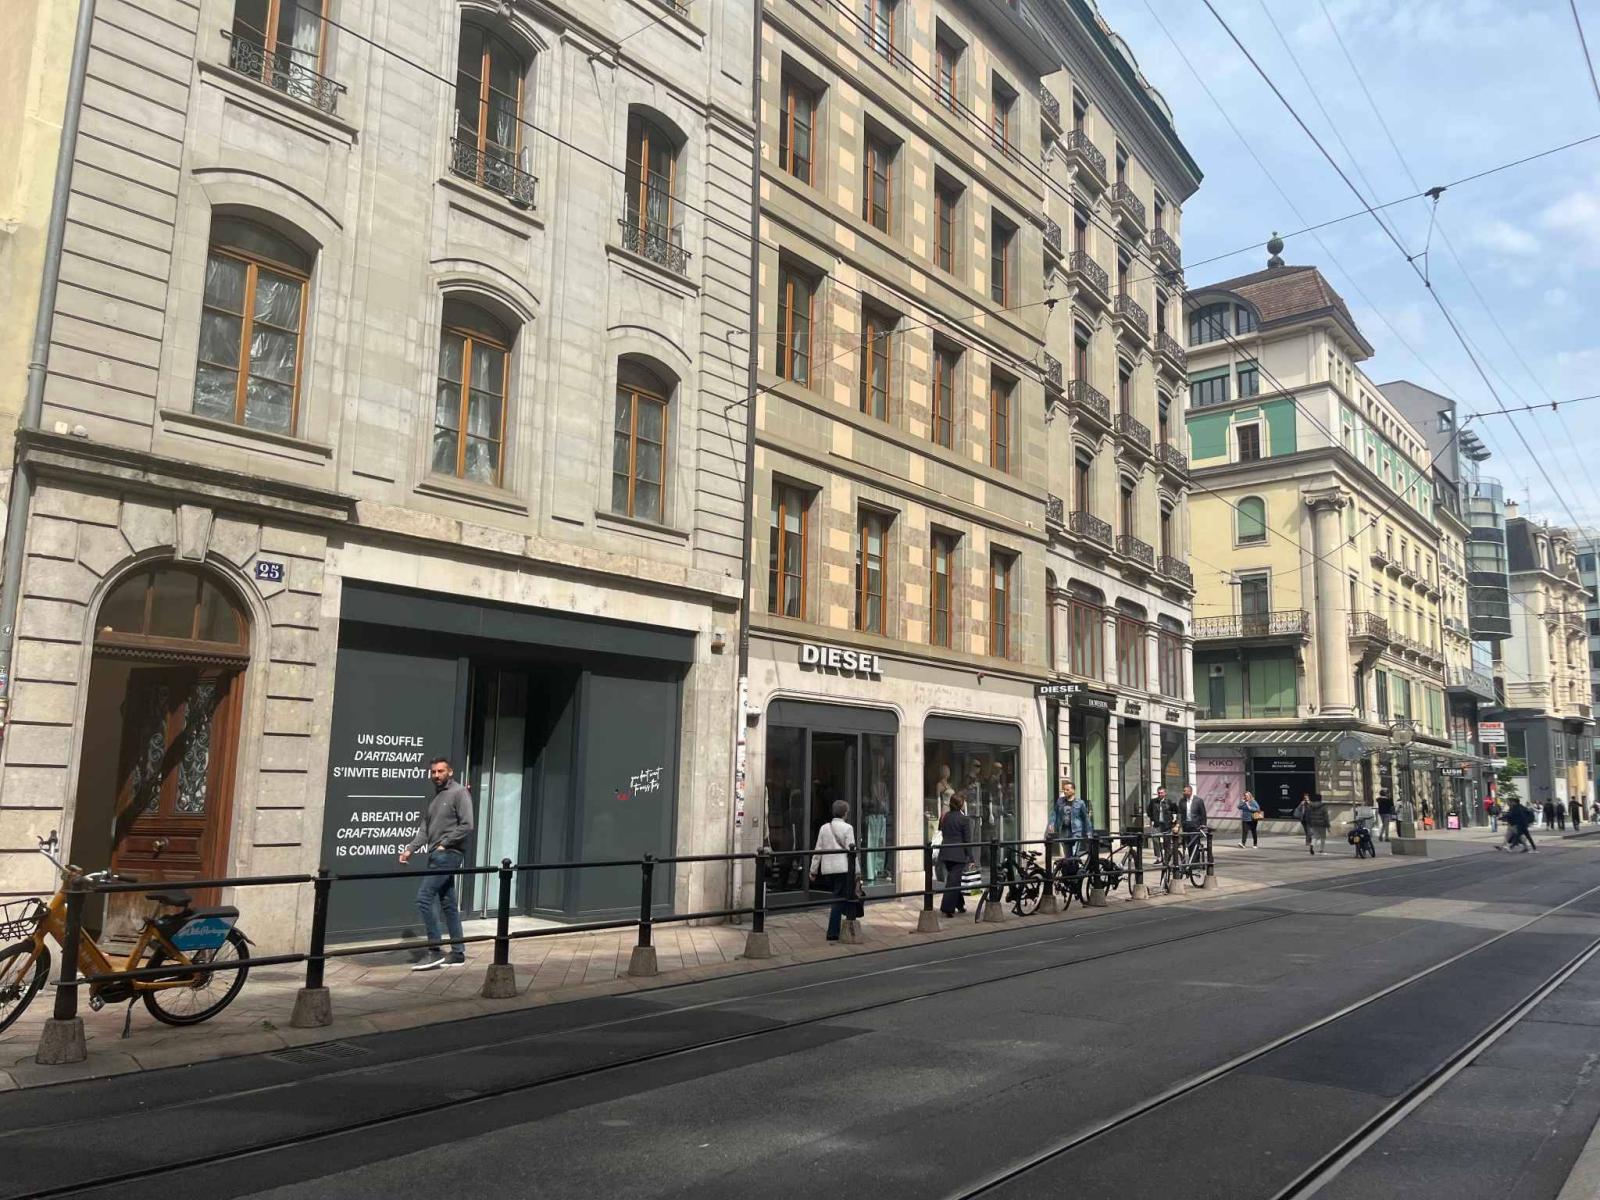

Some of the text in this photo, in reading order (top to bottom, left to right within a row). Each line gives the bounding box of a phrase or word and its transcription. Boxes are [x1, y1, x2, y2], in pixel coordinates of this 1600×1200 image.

[259, 563, 280, 579] 25
[801, 644, 884, 674] DIESEL
[1040, 685, 1081, 693] DIESEL
[357, 734, 424, 747] UN SOUFFLE
[354, 750, 424, 762] D'ARTISANAT
[333, 767, 379, 778] S'INVITE
[381, 767, 426, 779] BIENTÔT
[350, 811, 420, 822] A BREATH OF
[336, 827, 420, 839] CRAFTSMANSH
[336, 846, 347, 856] IS
[348, 844, 396, 856] COMING
